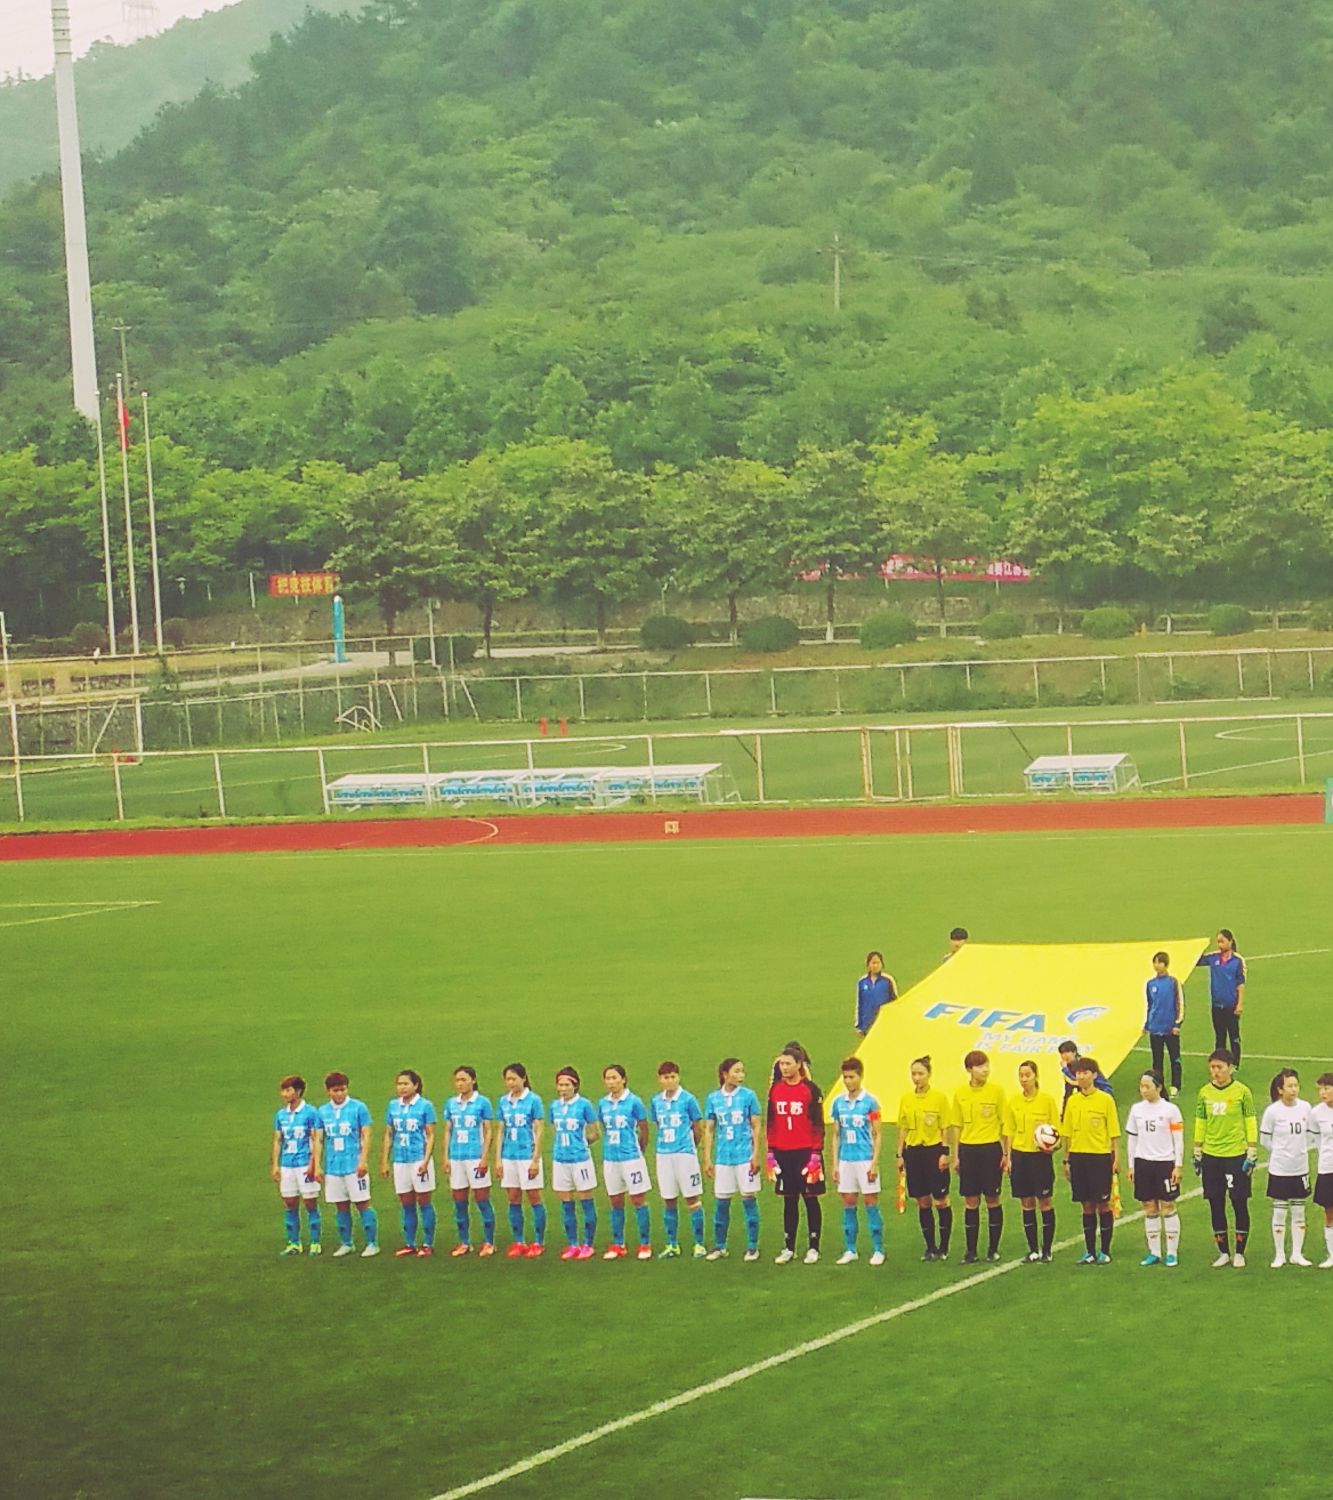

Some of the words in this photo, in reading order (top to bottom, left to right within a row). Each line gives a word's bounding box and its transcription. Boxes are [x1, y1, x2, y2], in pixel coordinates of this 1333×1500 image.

[923, 1002, 1046, 1033] FIFA
[1212, 1102, 1227, 1116] 22
[787, 1116, 792, 1130] 1
[1145, 1120, 1156, 1132] 15
[1290, 1122, 1302, 1134] 10
[631, 1171, 643, 1184] 23
